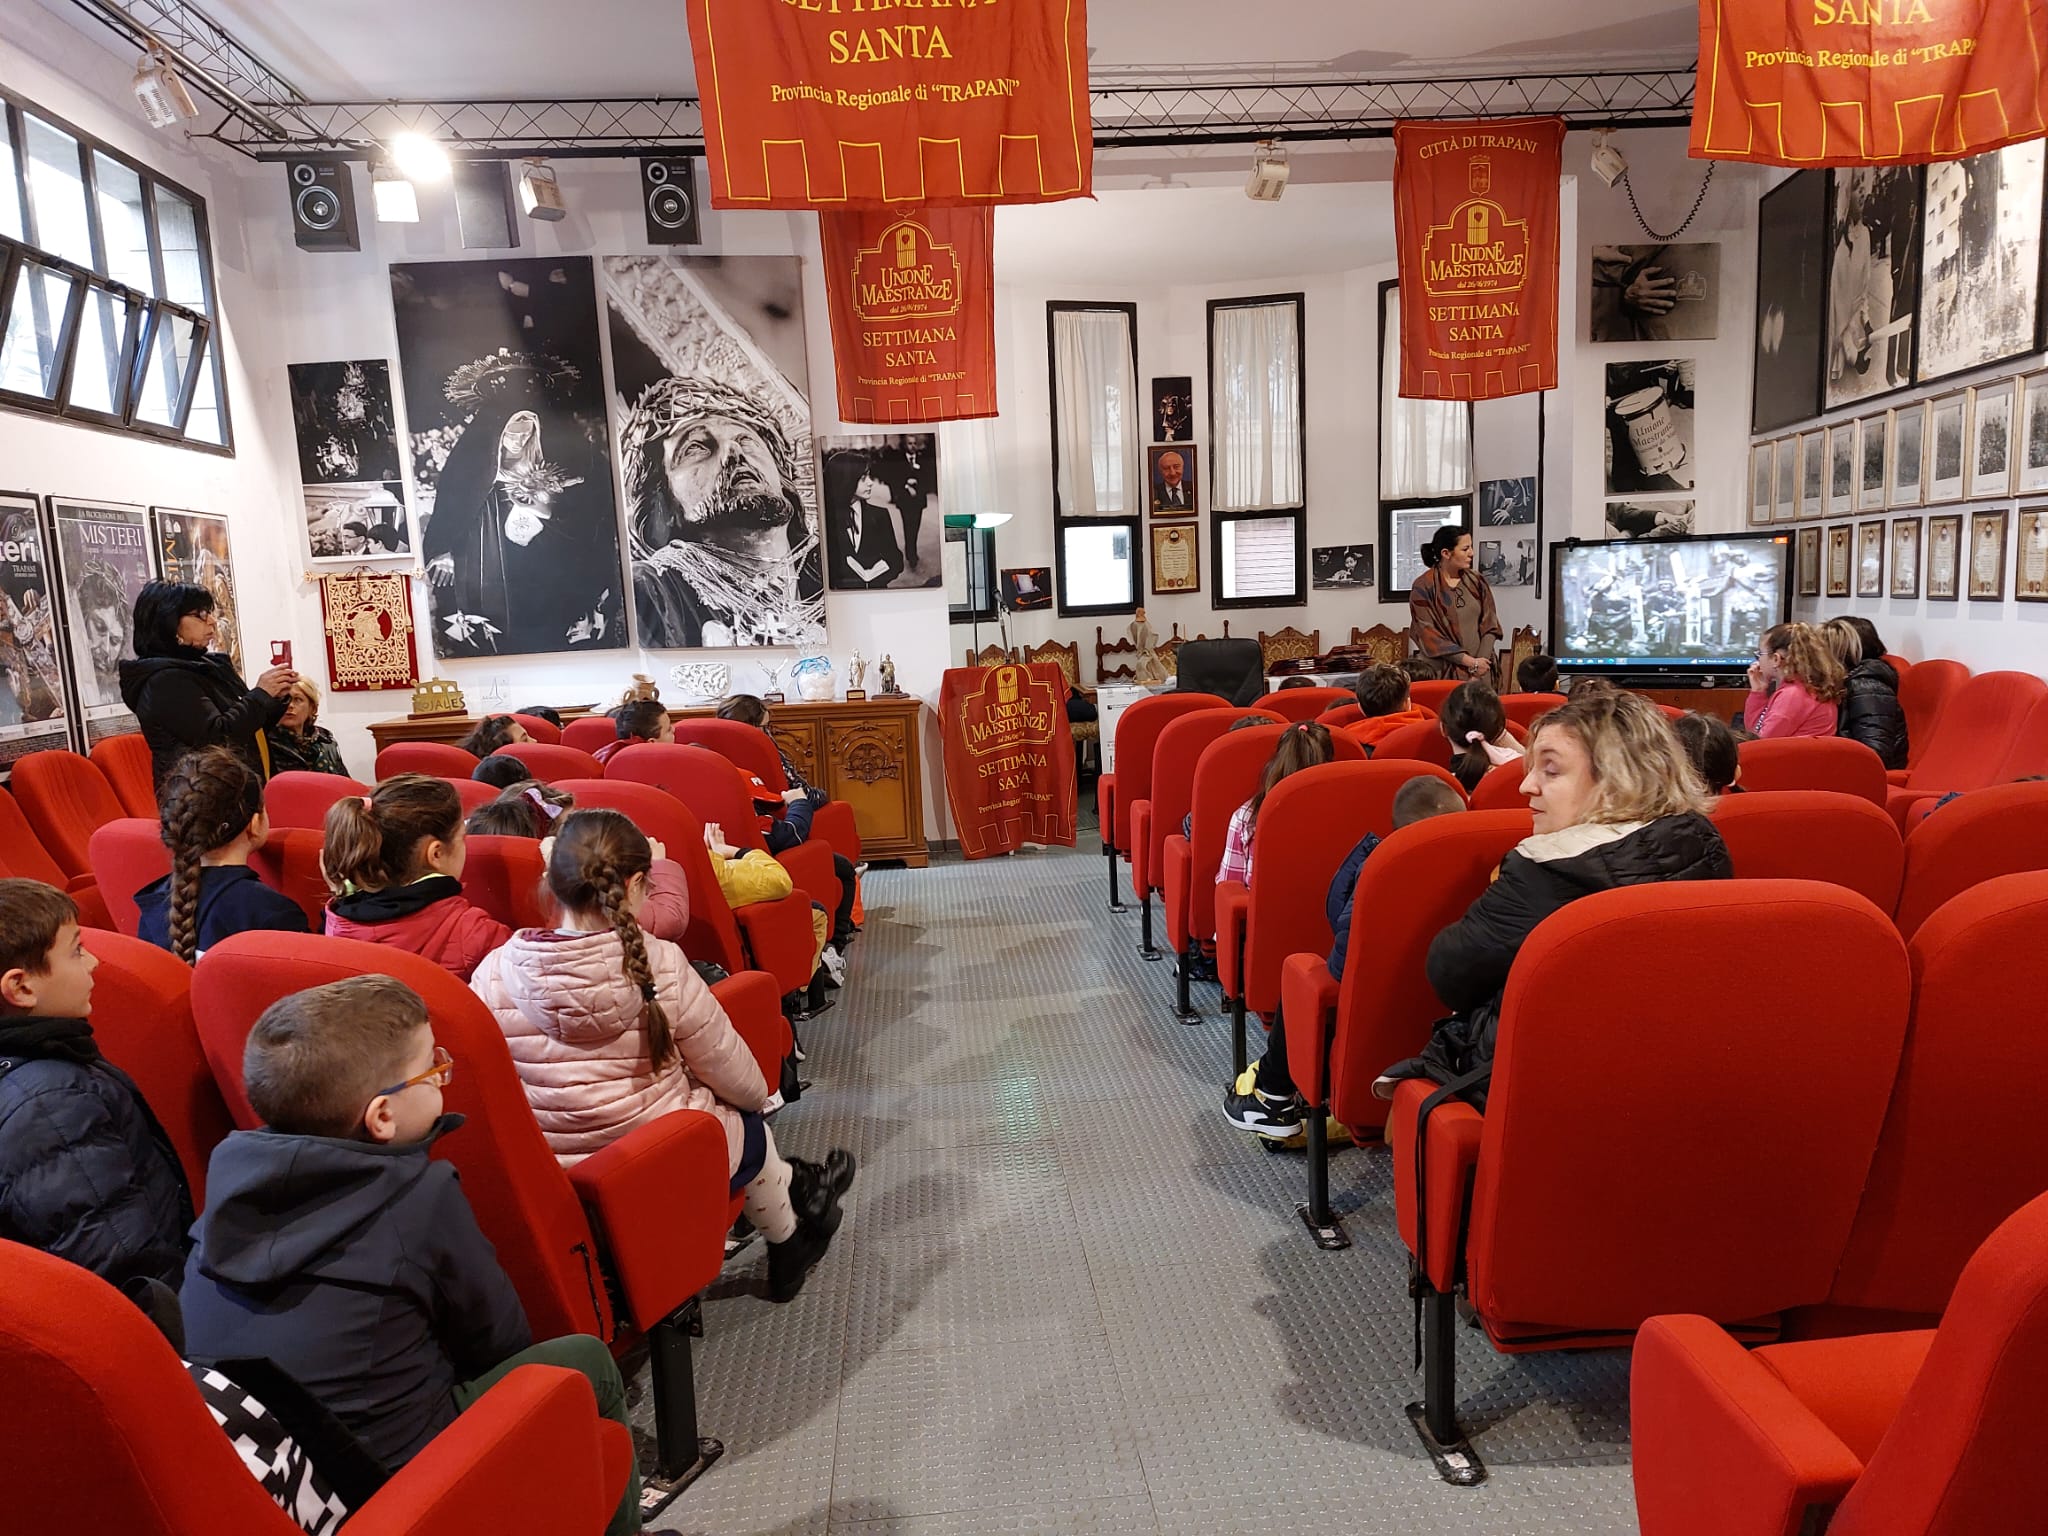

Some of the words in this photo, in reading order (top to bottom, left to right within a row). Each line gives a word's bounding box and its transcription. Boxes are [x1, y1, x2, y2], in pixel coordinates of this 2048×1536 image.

[1814, 0, 1935, 26] SANTA
[829, 24, 953, 64] SANTA
[1745, 47, 1814, 69] Provincia
[1817, 49, 1889, 69] Regionale
[1893, 48, 1908, 65] di
[771, 81, 833, 104] Provincia
[836, 85, 912, 111] Regionale
[915, 83, 928, 100] di
[1419, 136, 1460, 159] CITTÀ
[1462, 136, 1477, 149] DI
[1480, 135, 1539, 154] TRAPANI
[1451, 241, 1505, 265] UNIONE
[880, 264, 934, 290] UNIONE
[1430, 254, 1524, 281] MAESTRANZE
[861, 279, 953, 306] MAESTRANZE
[1429, 302, 1520, 321] SETTIMANA
[862, 326, 956, 347] SETTIMANA
[1449, 324, 1504, 341] SANTA
[885, 349, 938, 367] SANTA
[1485, 349, 1493, 357] di
[920, 375, 927, 383] di
[79, 523, 143, 547] MISTERI
[985, 697, 1032, 723] UNIONE
[998, 770, 1031, 791] SAA
